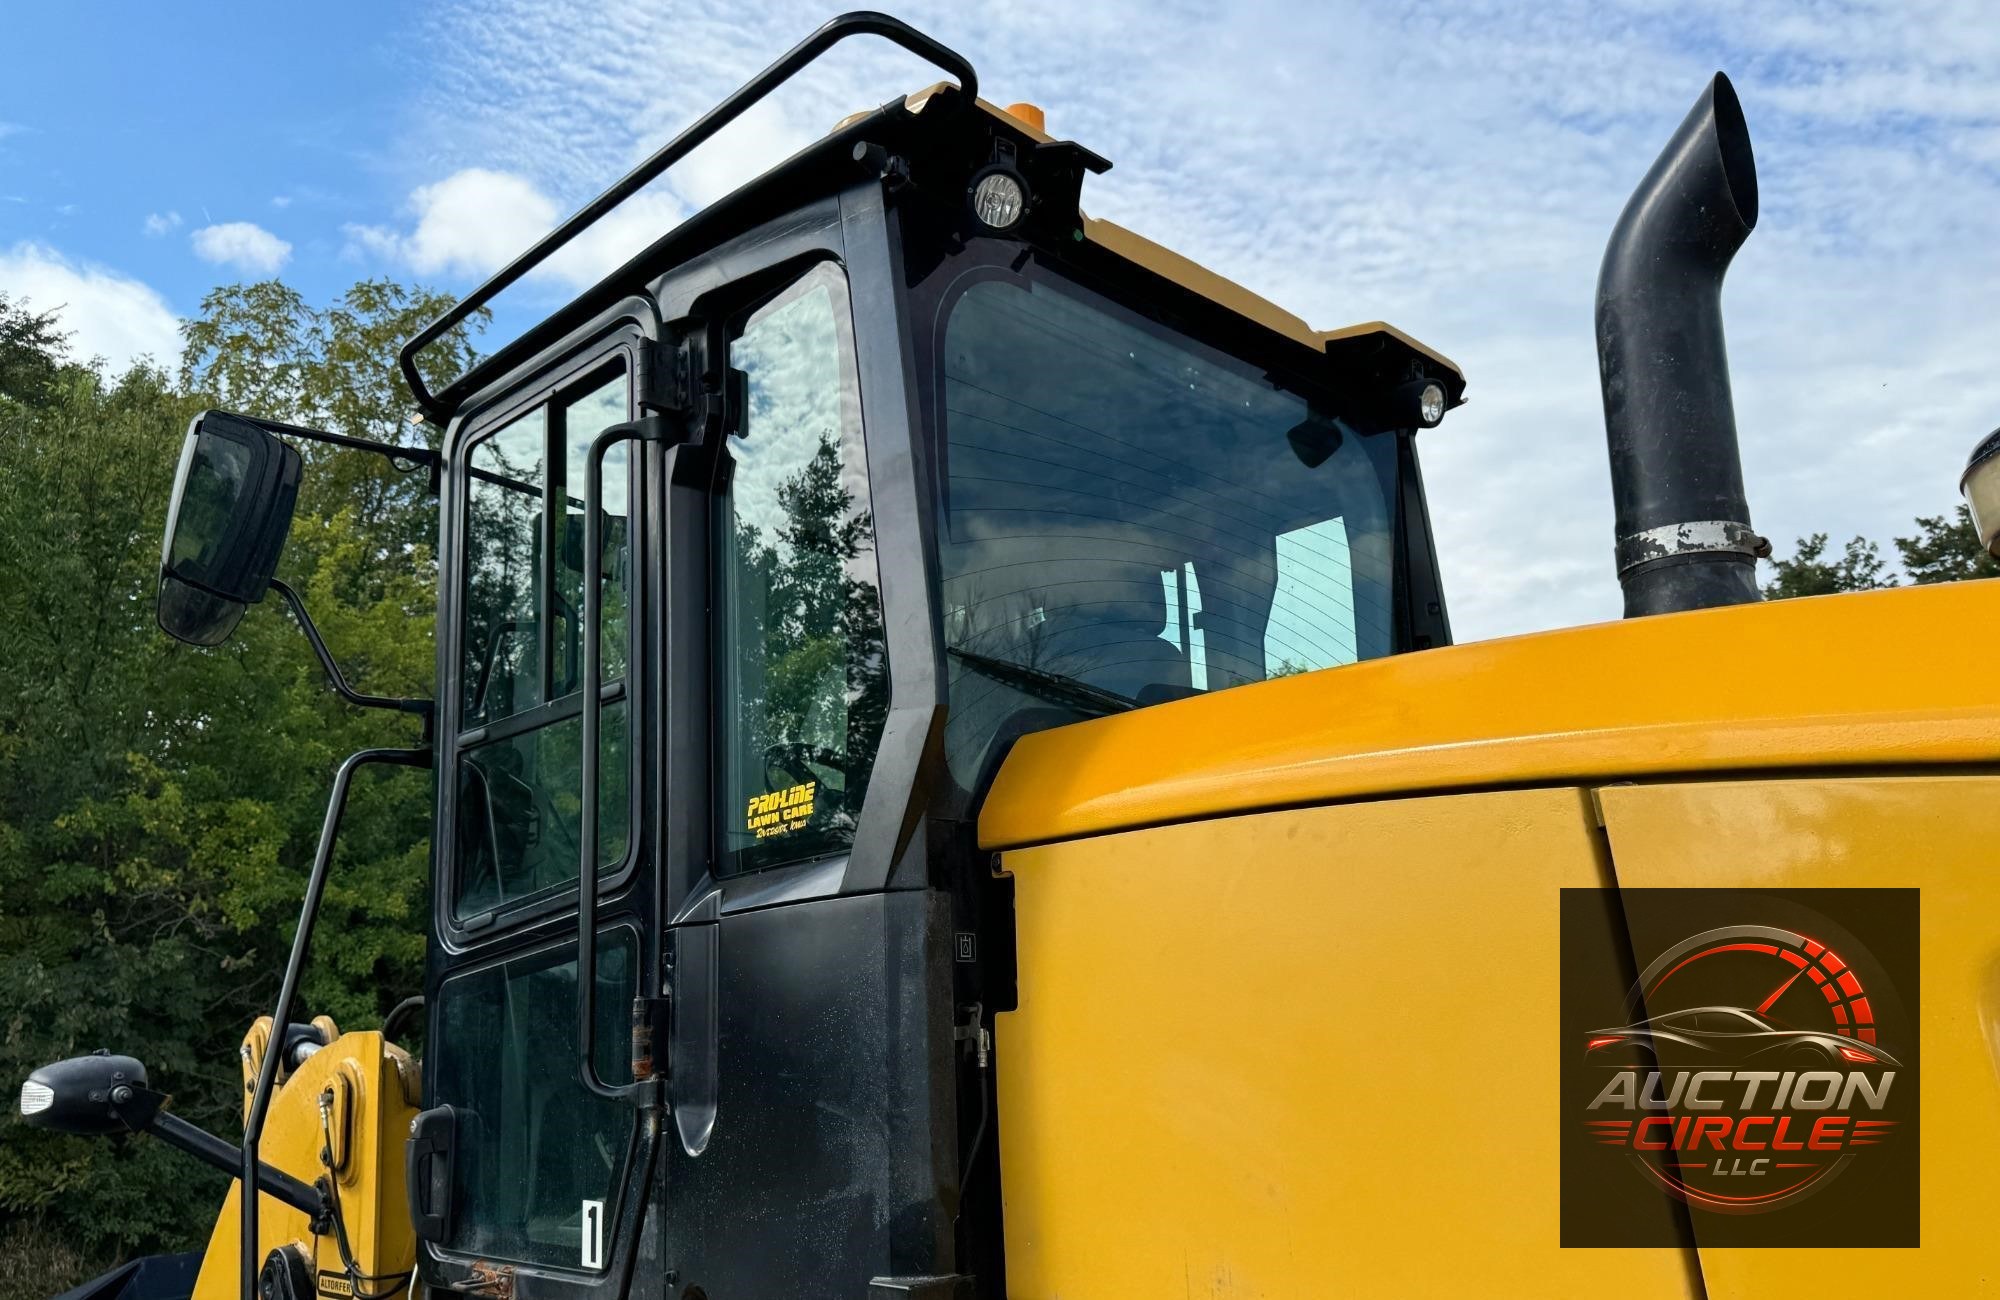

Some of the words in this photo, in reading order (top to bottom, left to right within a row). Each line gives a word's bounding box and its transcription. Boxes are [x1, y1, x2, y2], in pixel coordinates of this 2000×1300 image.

[747, 812, 780, 829] LAWN
[783, 803, 813, 820] CARE
[588, 1206, 597, 1263] 1
[320, 1277, 351, 1293] ALTORFER
